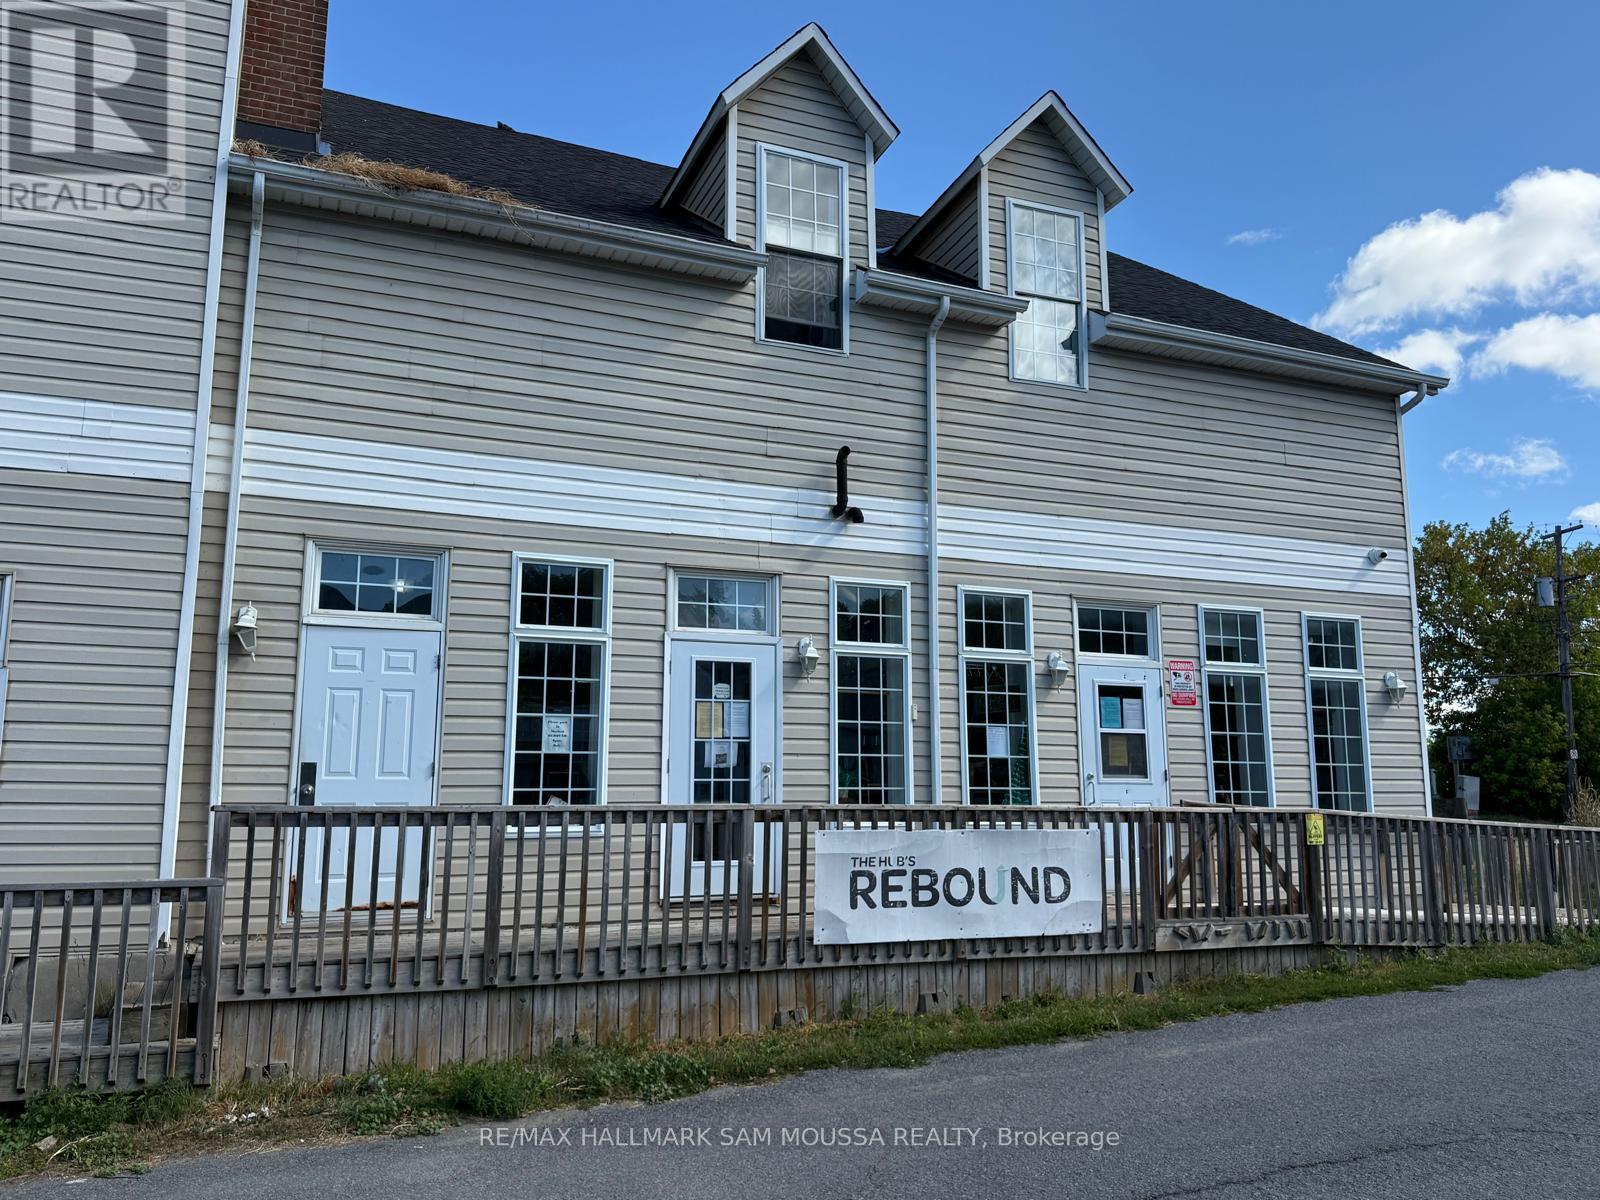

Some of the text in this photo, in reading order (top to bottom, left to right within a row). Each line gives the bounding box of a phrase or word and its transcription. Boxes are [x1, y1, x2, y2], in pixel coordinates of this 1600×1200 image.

[1169, 662, 1194, 670] WARNING
[851, 856, 876, 868] THE
[850, 865, 1072, 910] REBOUND
